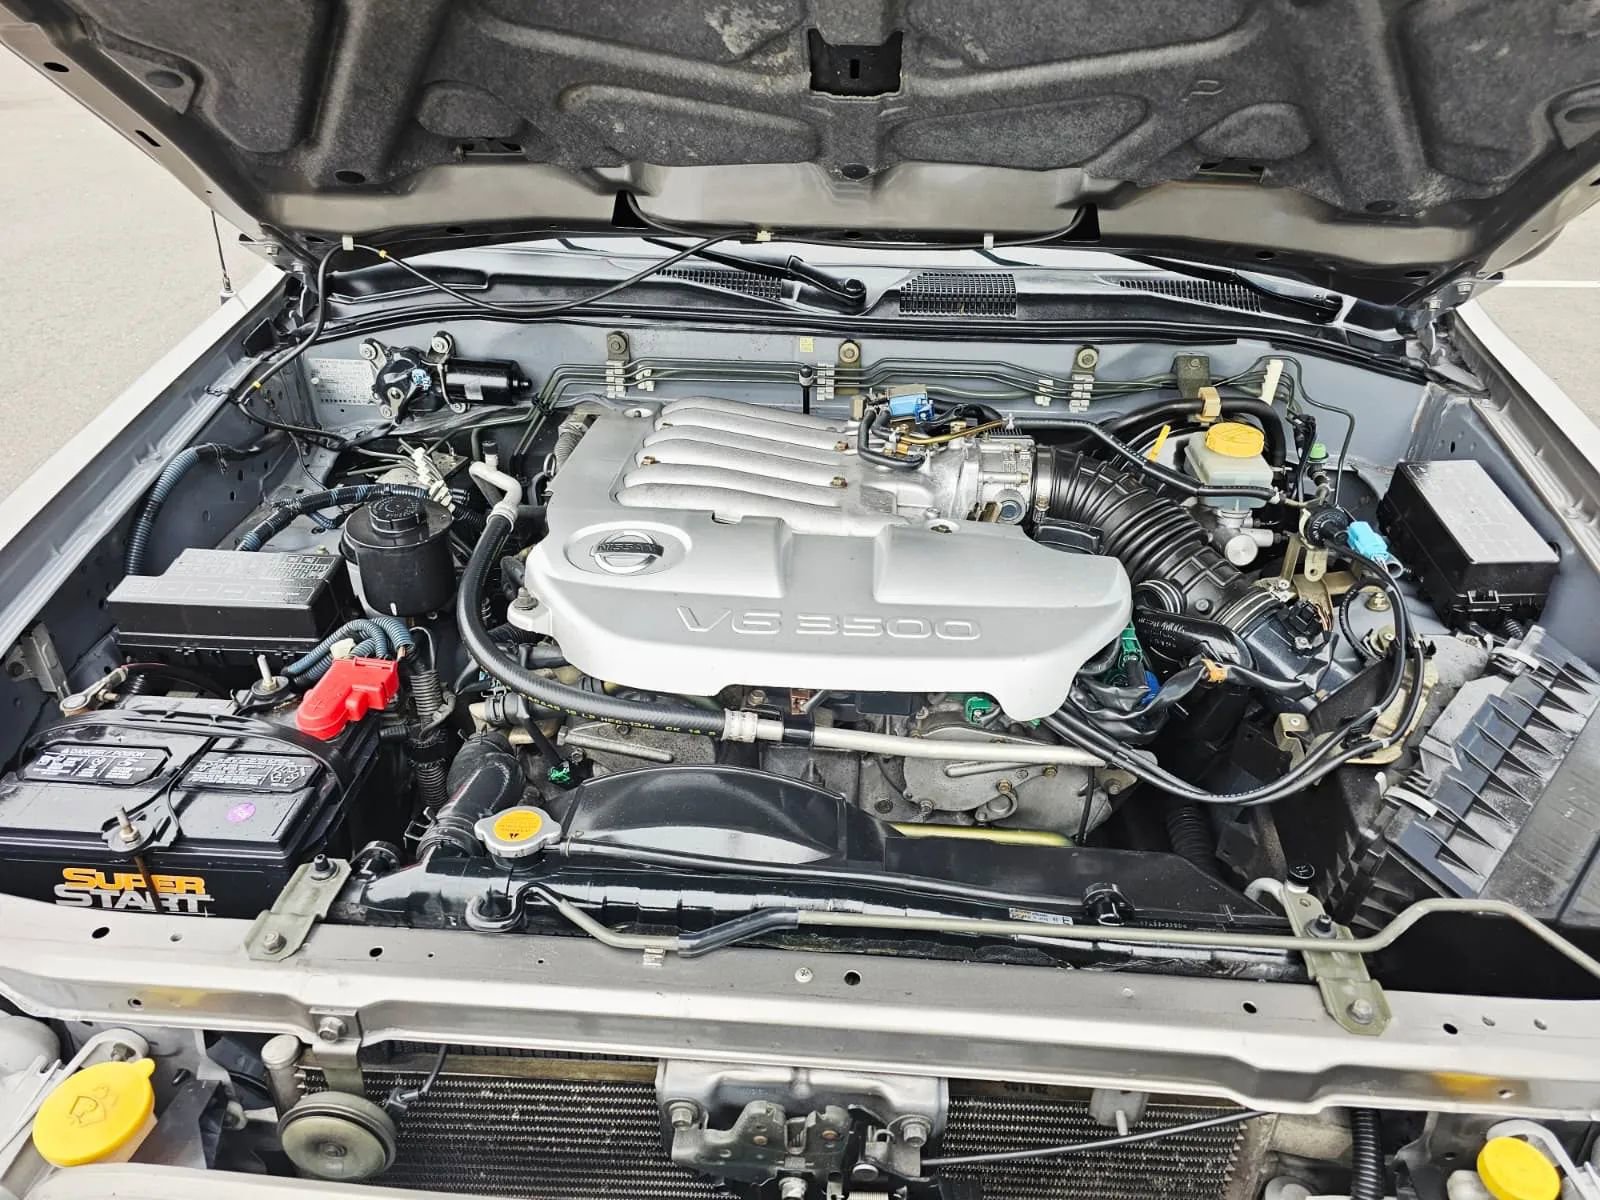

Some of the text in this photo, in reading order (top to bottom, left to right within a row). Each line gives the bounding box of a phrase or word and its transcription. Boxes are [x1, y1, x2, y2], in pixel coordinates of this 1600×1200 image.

[597, 543, 656, 553] NISSAN
[676, 605, 981, 640] V6 3500
[62, 867, 206, 895] SUPER
[53, 883, 216, 913] START
